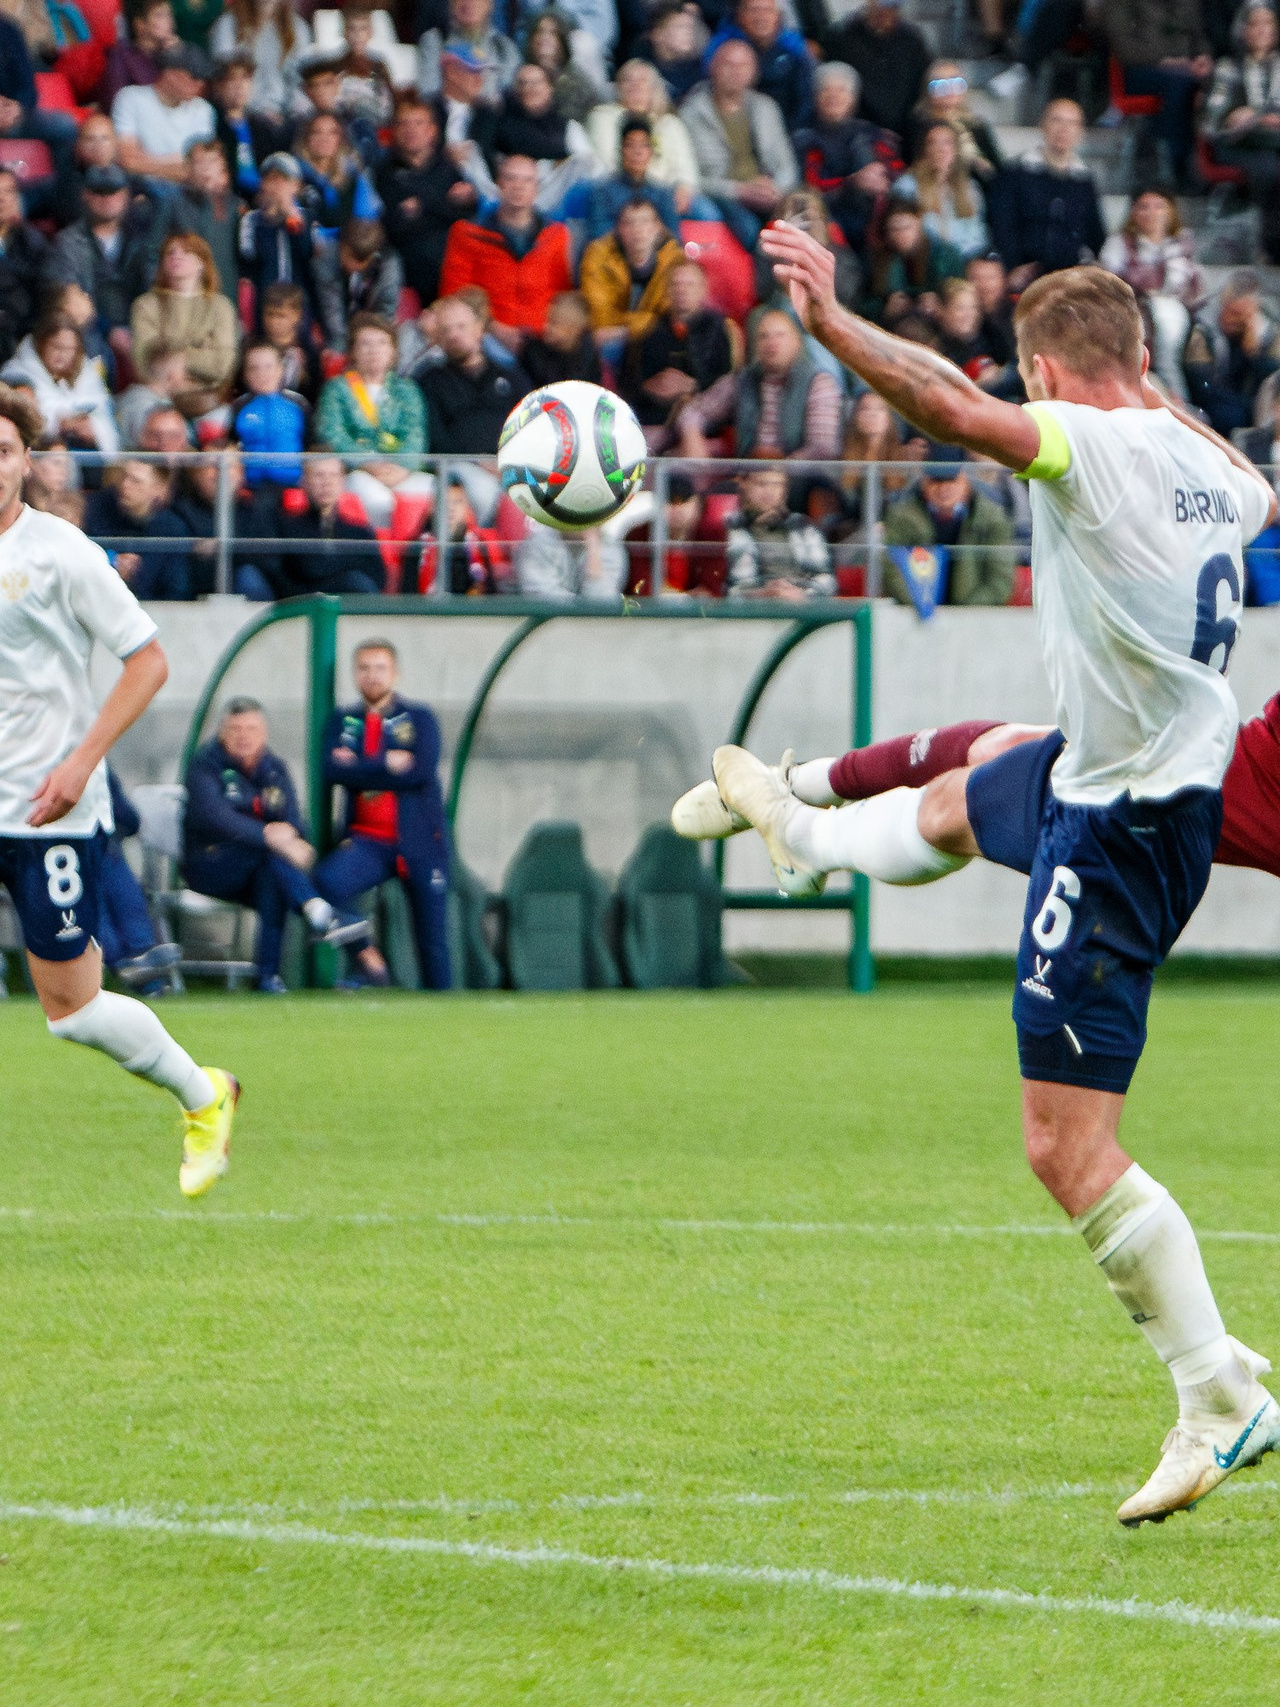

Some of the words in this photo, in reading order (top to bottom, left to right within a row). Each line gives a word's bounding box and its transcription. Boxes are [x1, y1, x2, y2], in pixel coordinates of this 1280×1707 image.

[1190, 552, 1240, 676] 6
[44, 844, 84, 909] 8
[1032, 865, 1081, 951] 6
